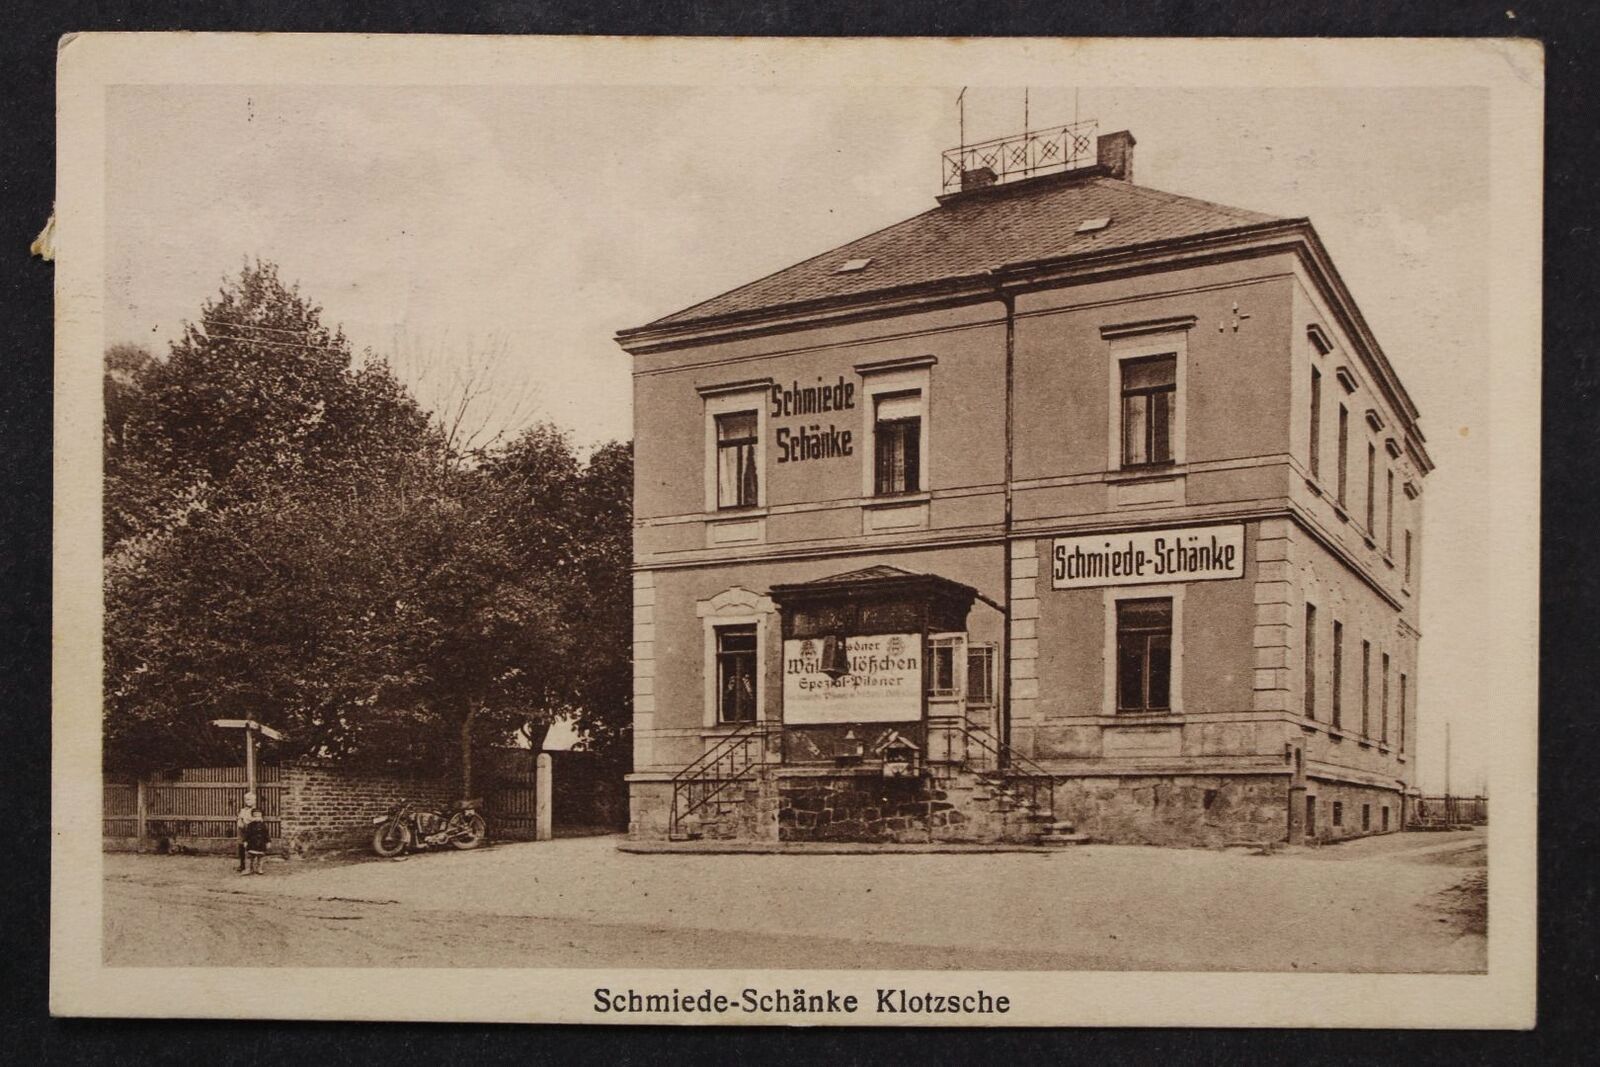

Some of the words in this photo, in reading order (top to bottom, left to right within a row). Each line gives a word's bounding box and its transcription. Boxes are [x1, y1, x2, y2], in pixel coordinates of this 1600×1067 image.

[771, 376, 855, 417] Schmiede
[776, 424, 853, 463] Schänke
[1055, 535, 1236, 580] Schmiede-Schänke
[593, 988, 858, 1014] Schmiede-Schänke
[876, 988, 1010, 1014] Klotzsche
